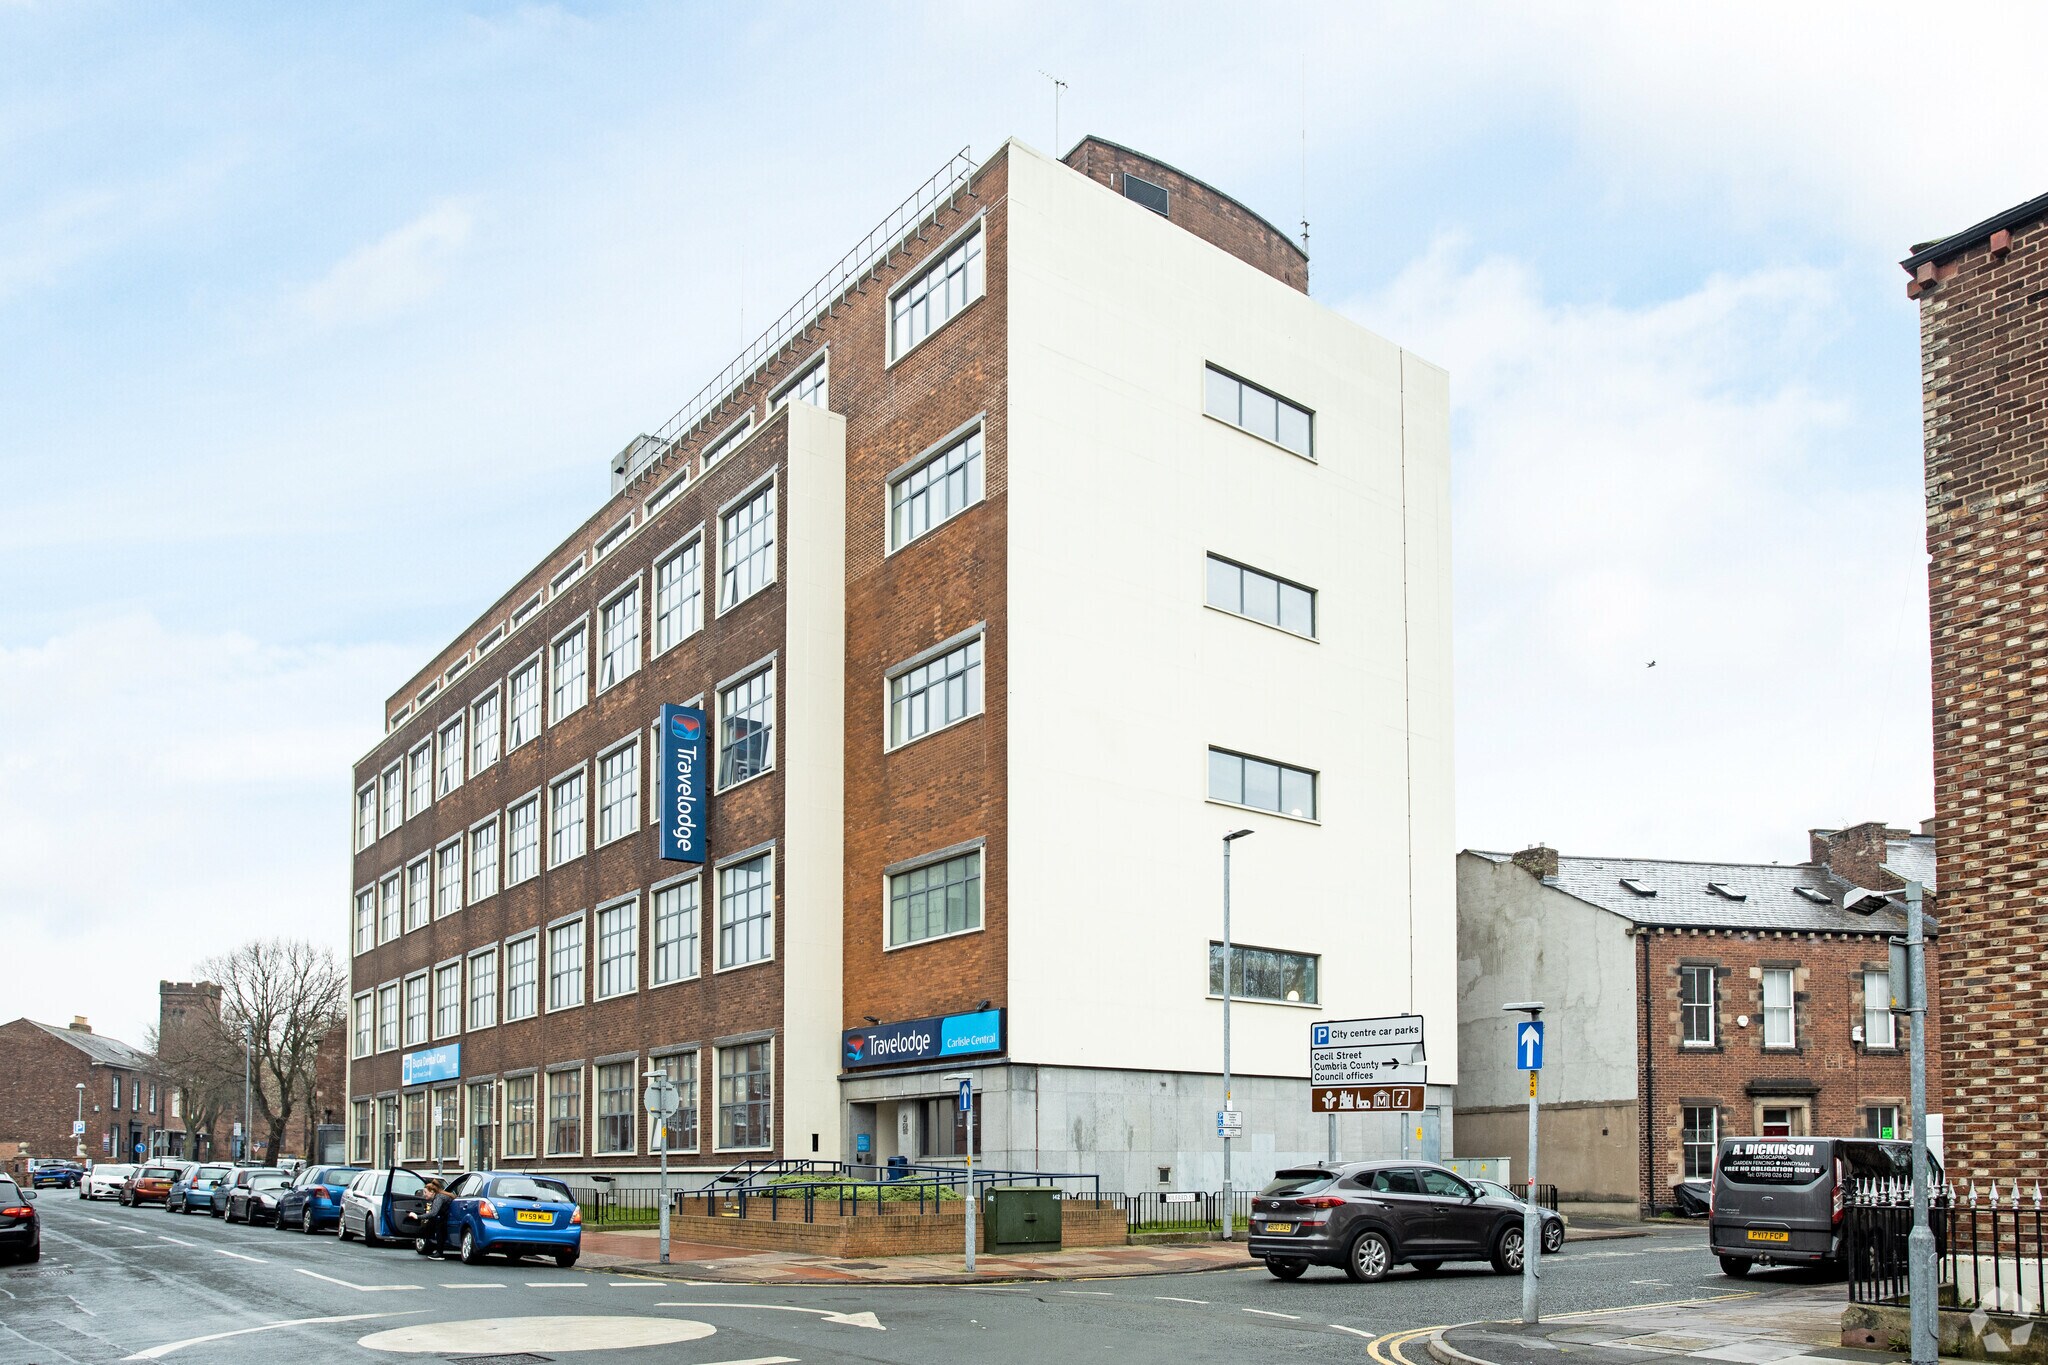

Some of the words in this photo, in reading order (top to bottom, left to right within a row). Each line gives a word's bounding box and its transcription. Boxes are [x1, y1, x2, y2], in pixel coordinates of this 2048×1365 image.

[672, 745, 697, 852] Travelodge
[947, 1036, 971, 1048] Carlisle
[971, 1033, 996, 1045] Central
[1318, 1029, 1327, 1043] P
[1331, 1030, 1348, 1040] City
[1350, 1029, 1376, 1038] centre
[1379, 1028, 1392, 1036] car
[1394, 1025, 1419, 1036] parks
[868, 1030, 930, 1056] Travelodge
[1314, 1052, 1334, 1061] Cecil
[1336, 1051, 1362, 1060] Street
[1314, 1062, 1348, 1071] Cumbria
[1349, 1060, 1379, 1070] County
[1314, 1072, 1344, 1081] Council
[1346, 1071, 1374, 1080] offices
[1732, 1144, 1743, 1155] A.
[1745, 1143, 1815, 1156] DICKINSON
[1752, 1231, 1768, 1239] PY17
[1769, 1232, 1784, 1240] FCP
